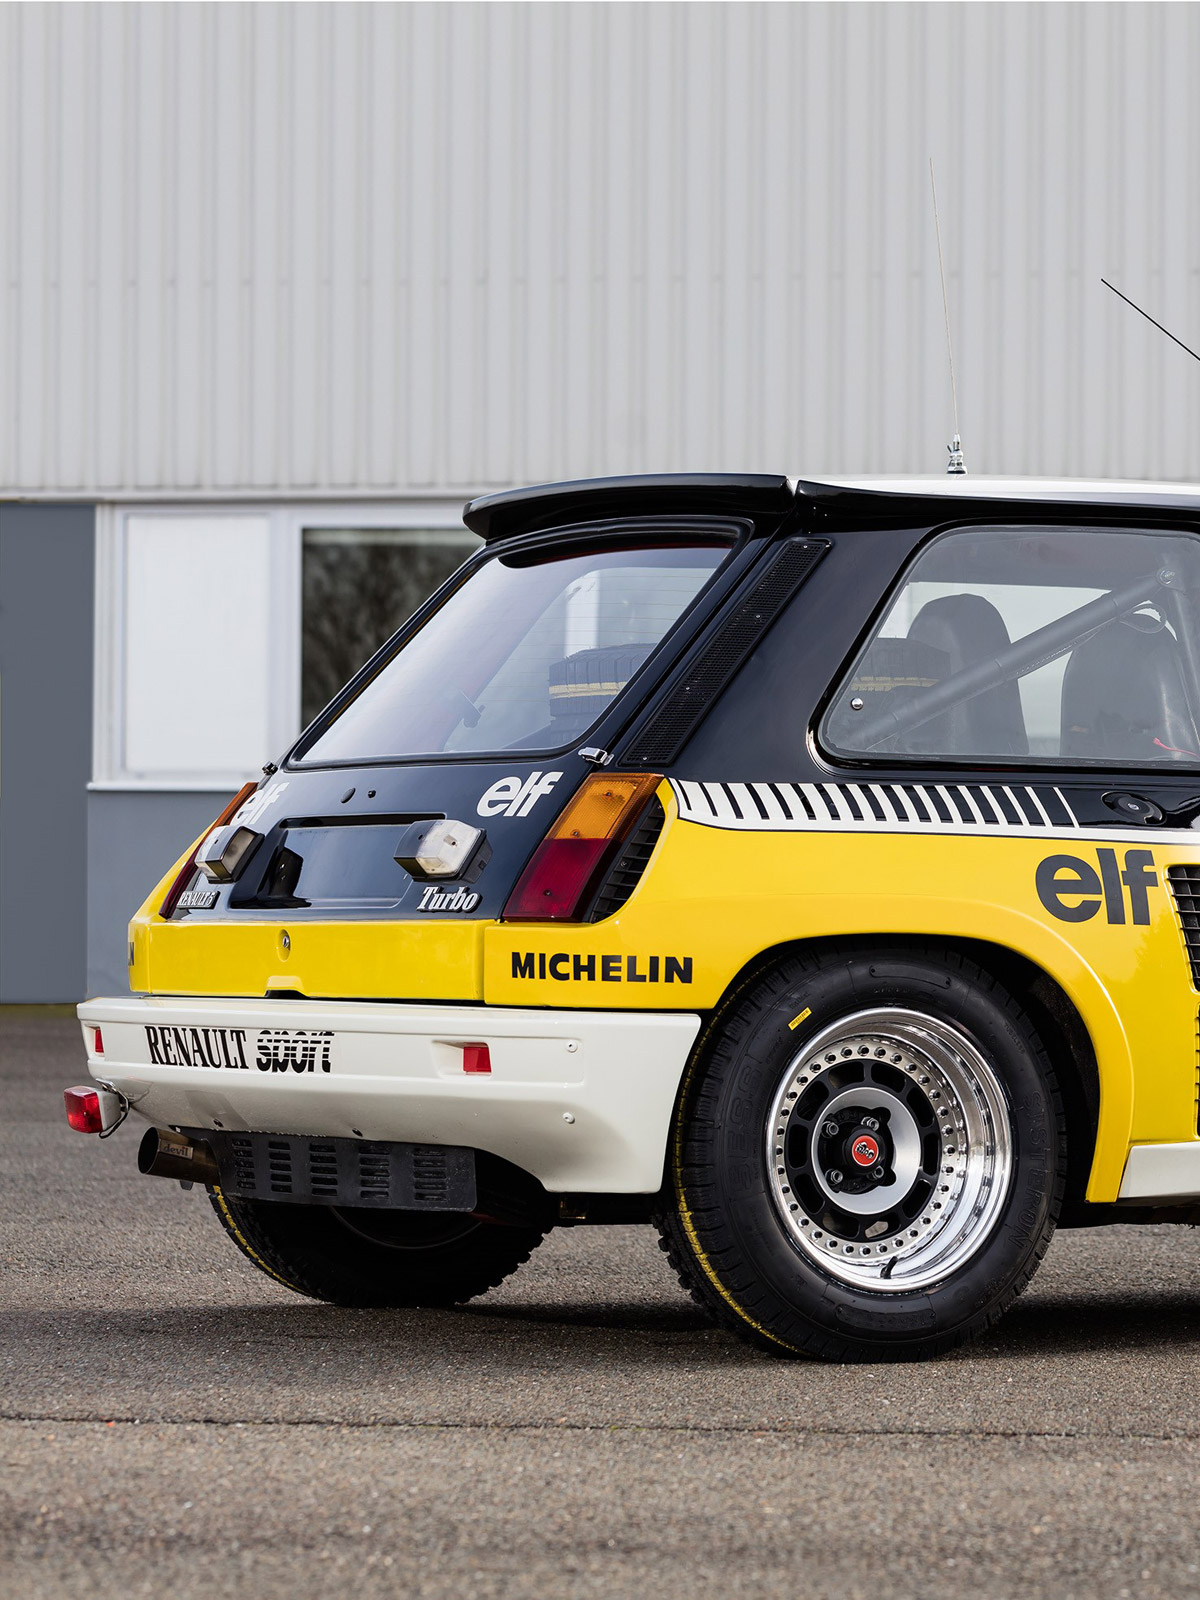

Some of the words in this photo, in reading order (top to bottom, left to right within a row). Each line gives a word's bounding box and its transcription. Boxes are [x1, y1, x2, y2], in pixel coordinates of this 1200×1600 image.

[229, 783, 290, 825] elf
[477, 772, 564, 817] elf
[416, 886, 482, 912] Turbo
[1035, 848, 1159, 926] elf
[511, 951, 693, 984] MICHELIN
[144, 1025, 249, 1069] RENAULT
[255, 1030, 335, 1074] sport
[163, 1143, 189, 1157] devil
